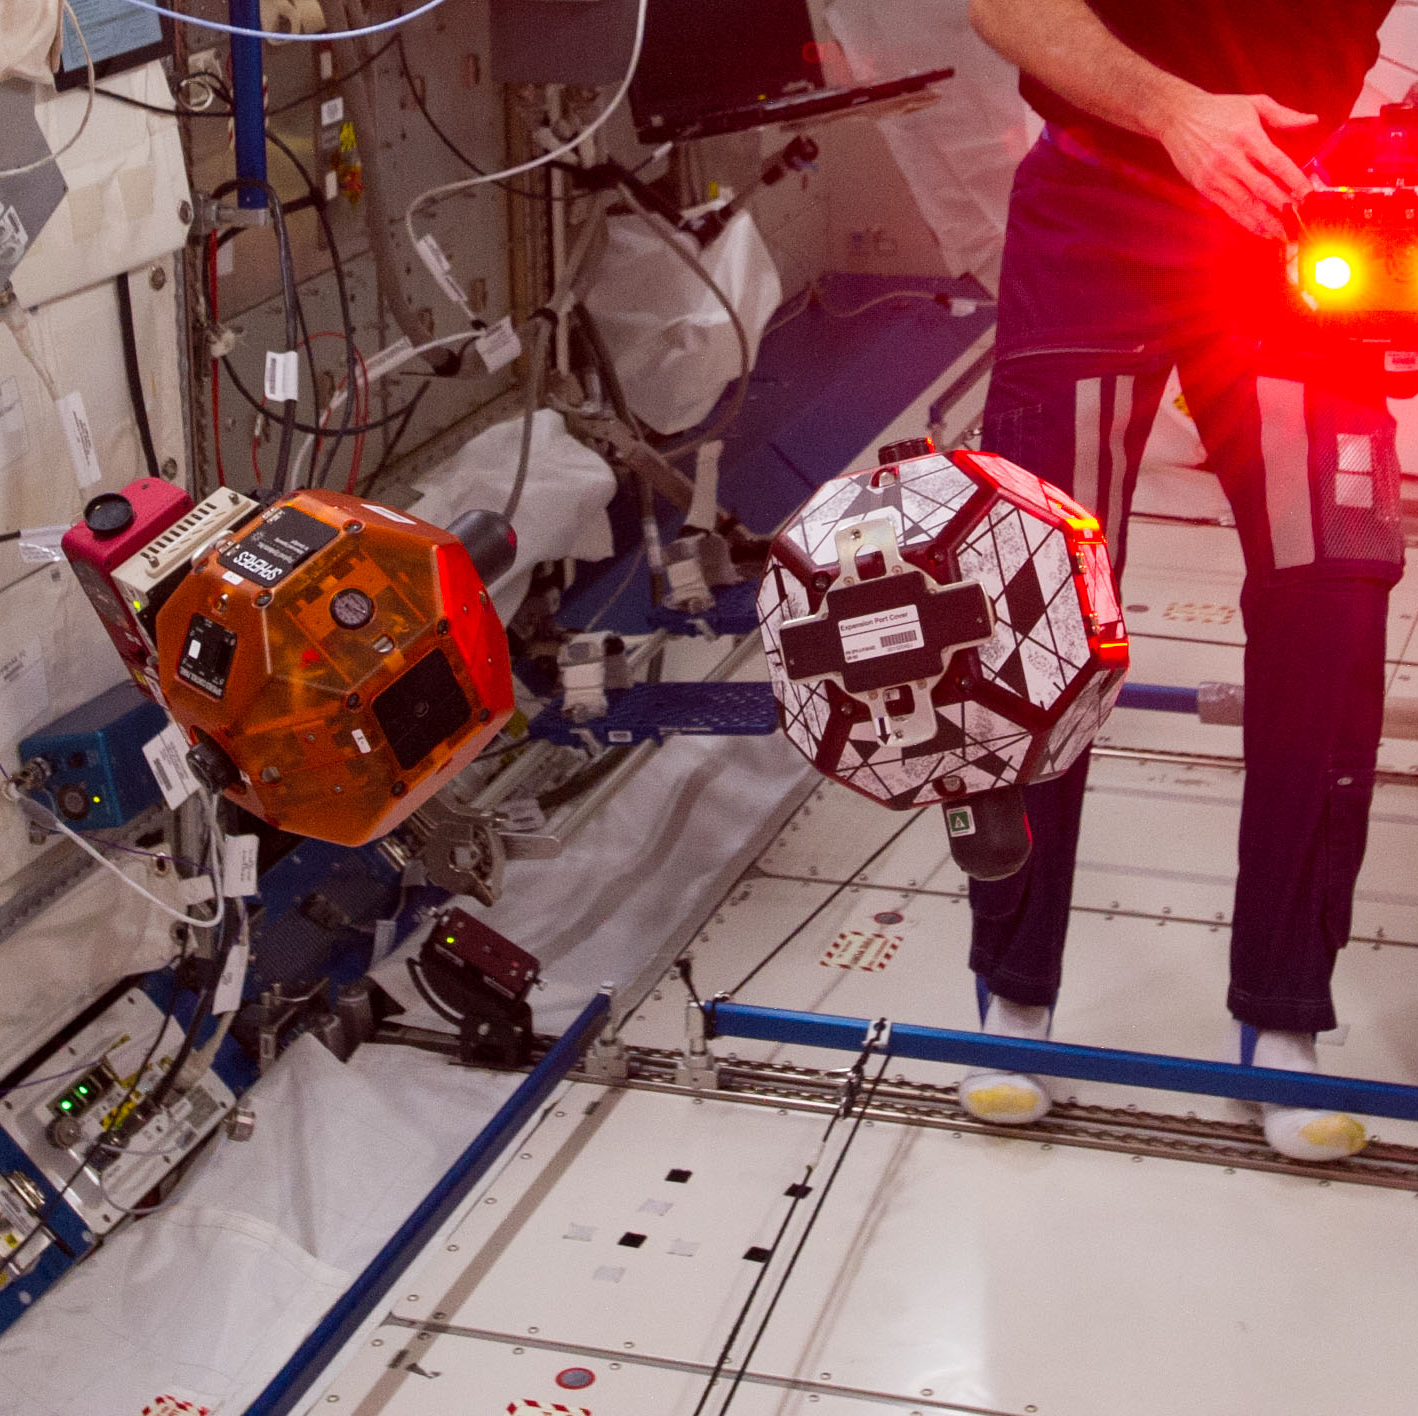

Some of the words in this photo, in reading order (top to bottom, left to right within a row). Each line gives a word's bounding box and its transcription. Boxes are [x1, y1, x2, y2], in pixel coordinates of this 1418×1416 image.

[233, 550, 283, 582] SPHERES
[841, 619, 874, 632] Expansion
[874, 616, 889, 624] Port
[889, 612, 908, 621] Cover
